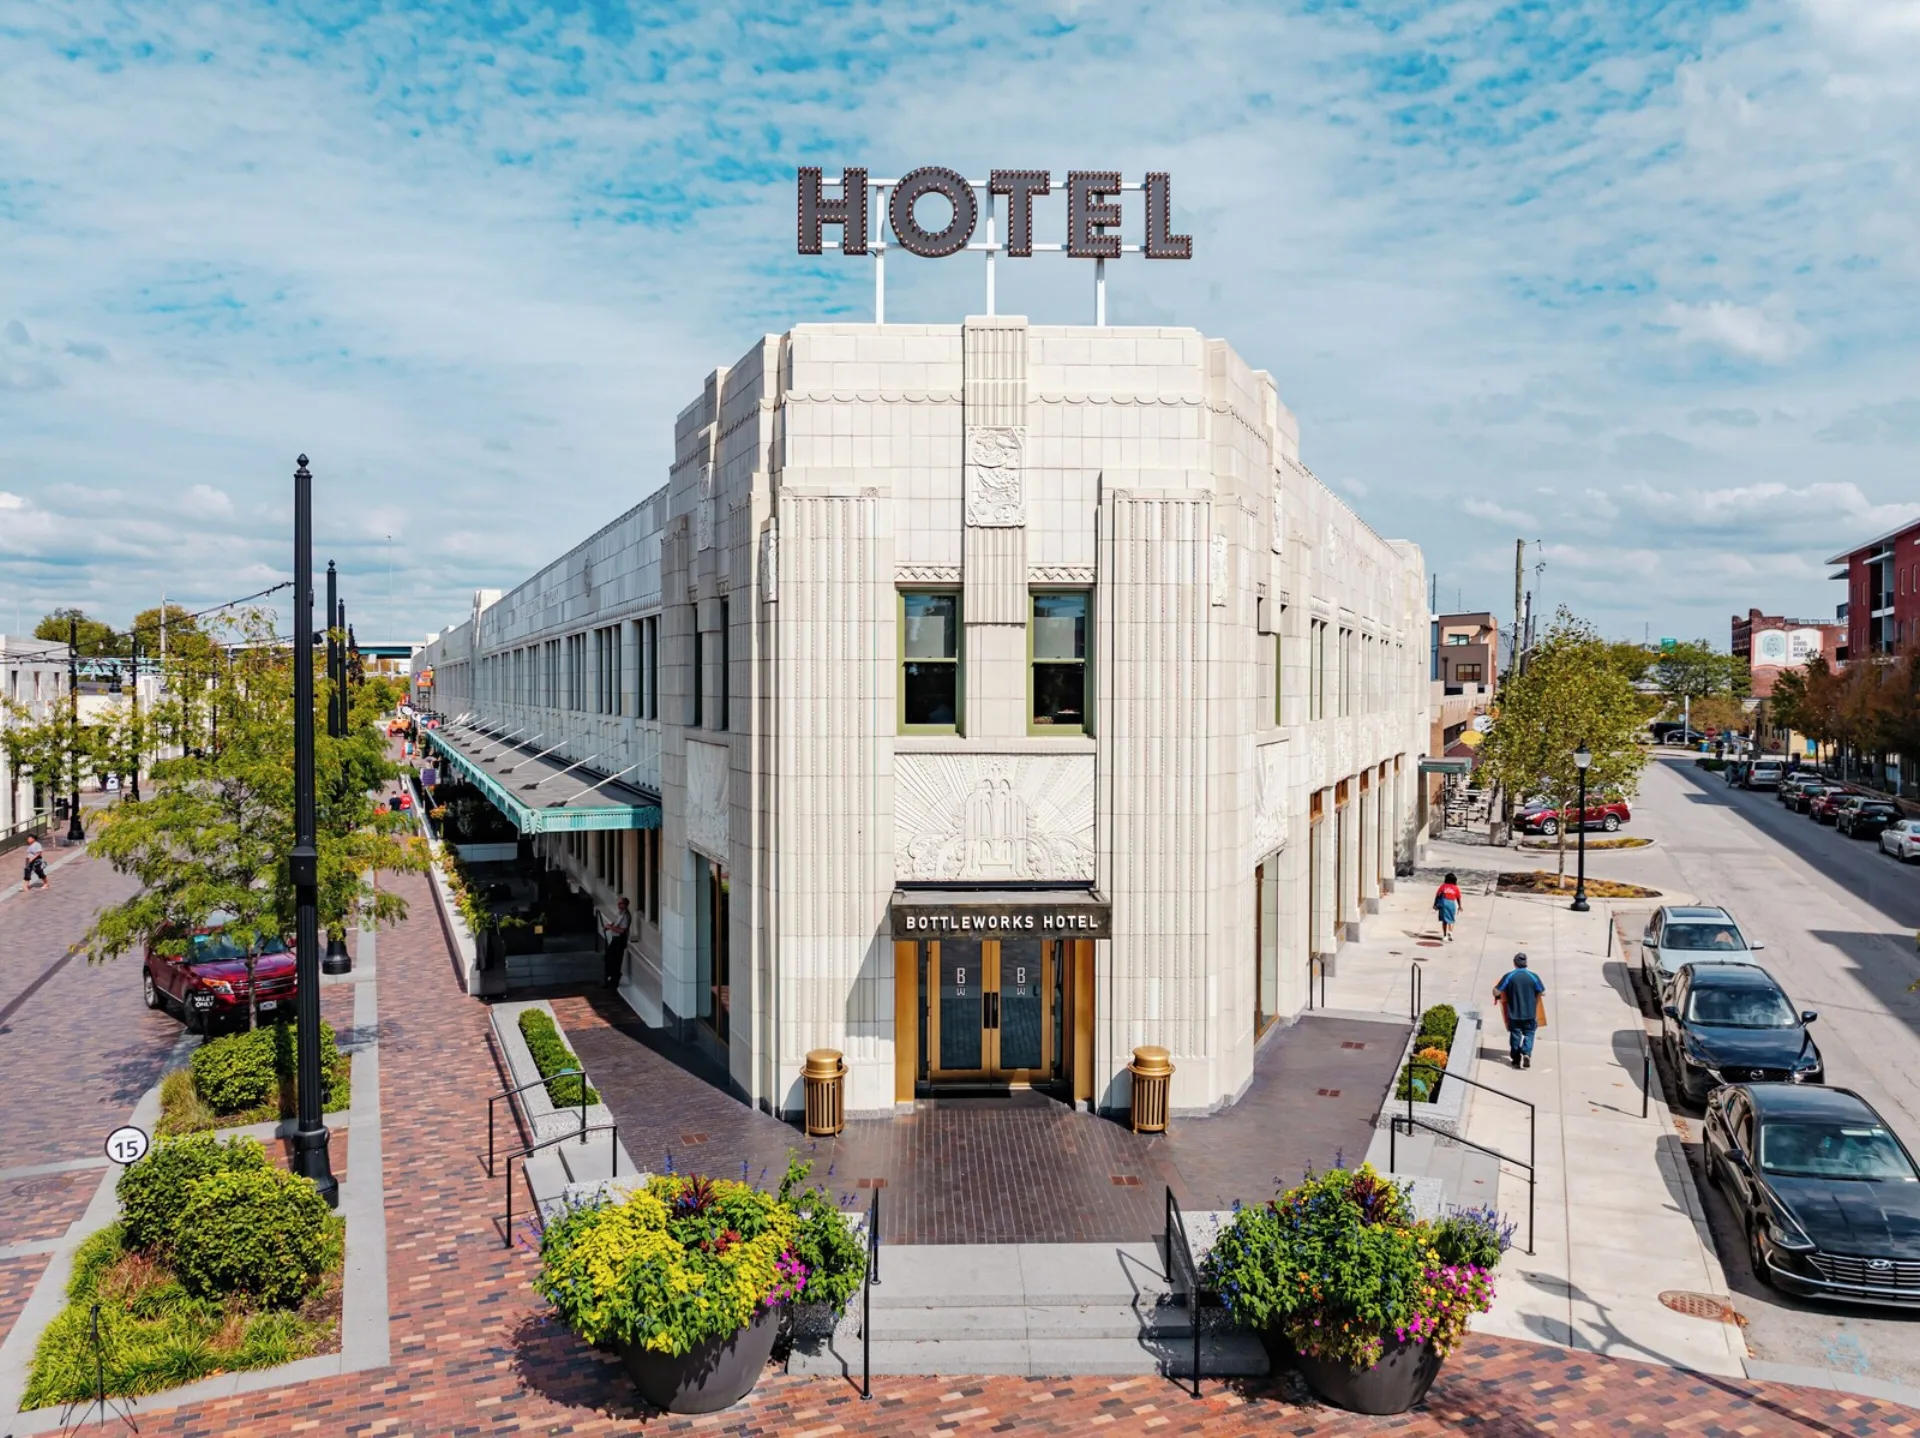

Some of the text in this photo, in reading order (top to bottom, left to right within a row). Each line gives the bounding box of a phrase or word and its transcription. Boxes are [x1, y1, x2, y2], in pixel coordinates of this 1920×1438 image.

[798, 166, 1193, 259] HOTEL
[906, 915, 1098, 929] BOTTLEWORKS HOTEL
[957, 967, 966, 984] B
[1017, 967, 1026, 983] B
[114, 1140, 139, 1158] 15
